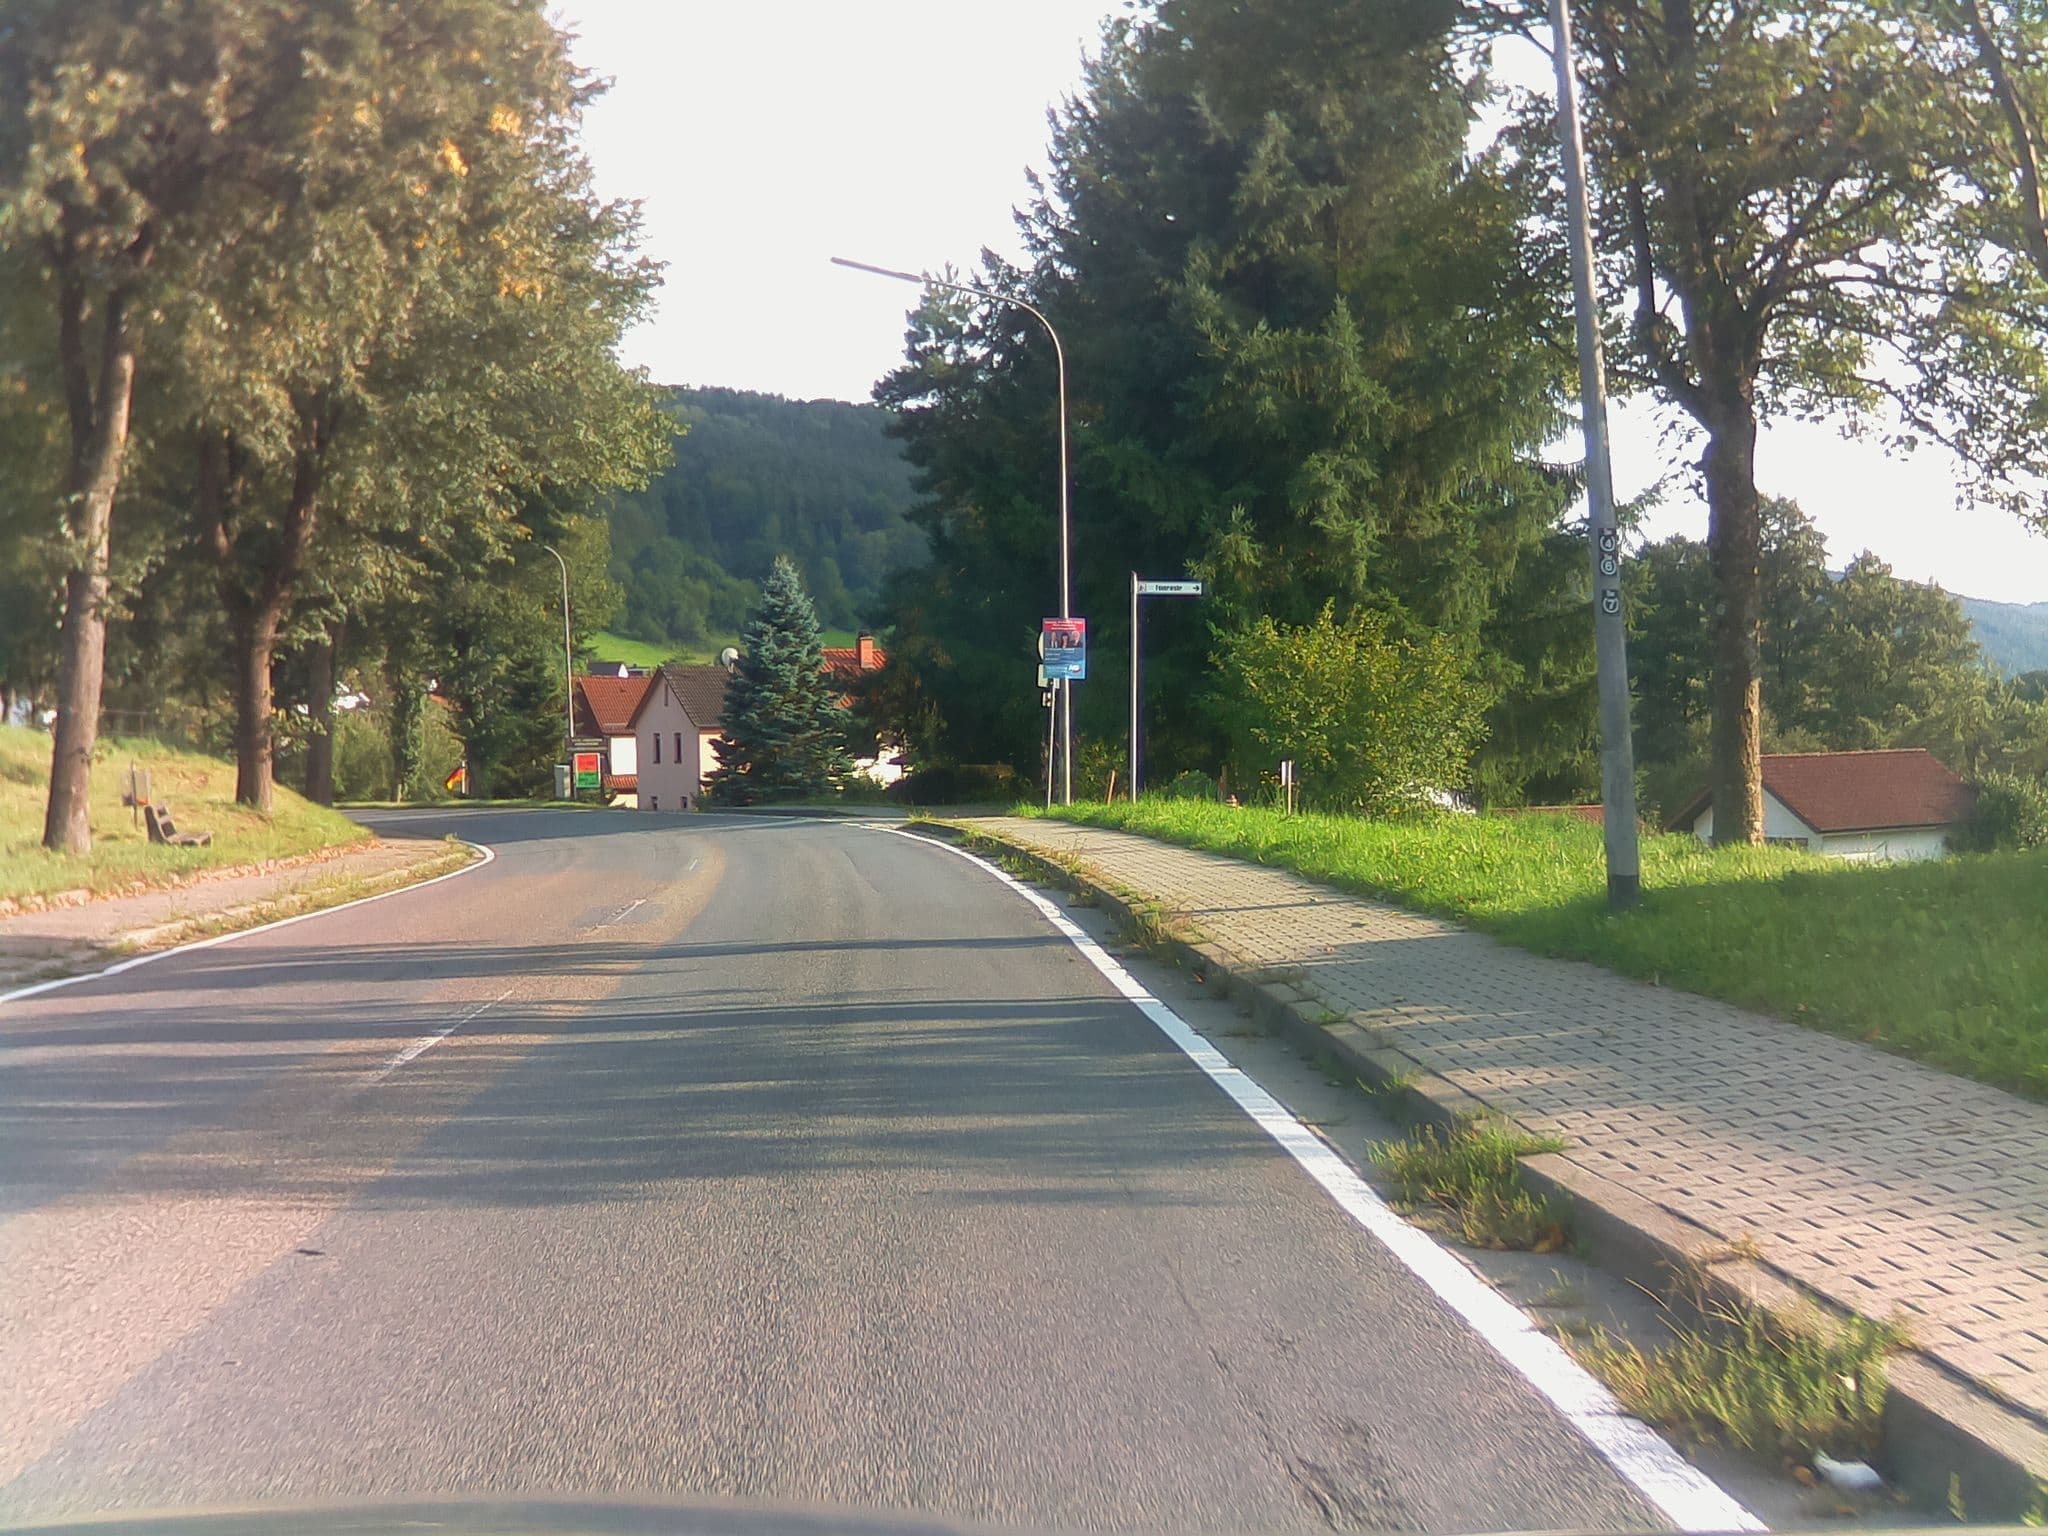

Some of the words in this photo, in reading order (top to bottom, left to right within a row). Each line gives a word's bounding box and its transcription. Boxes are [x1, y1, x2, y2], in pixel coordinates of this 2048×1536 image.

[1605, 539, 1612, 548] 4
[1605, 562, 1612, 571] 6
[1607, 600, 1614, 610] 7
